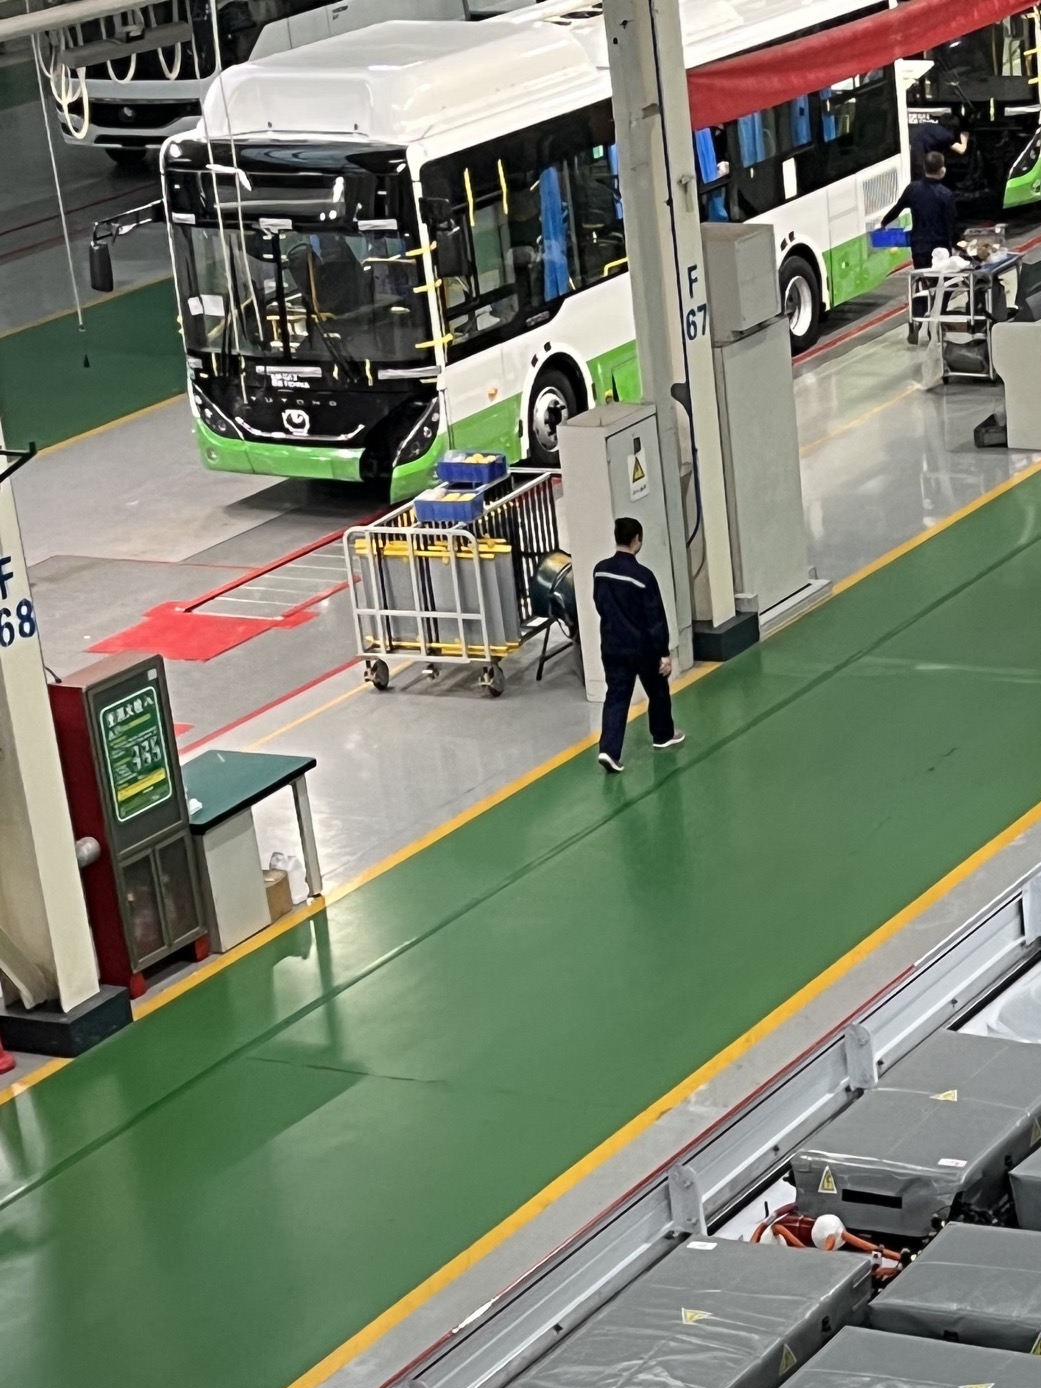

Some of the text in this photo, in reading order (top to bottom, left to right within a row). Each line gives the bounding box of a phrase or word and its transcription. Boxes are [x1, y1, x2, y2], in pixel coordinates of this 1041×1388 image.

[687, 264, 698, 299] F
[686, 303, 707, 341] 67
[0, 556, 14, 600] F
[0, 598, 36, 647] 68
